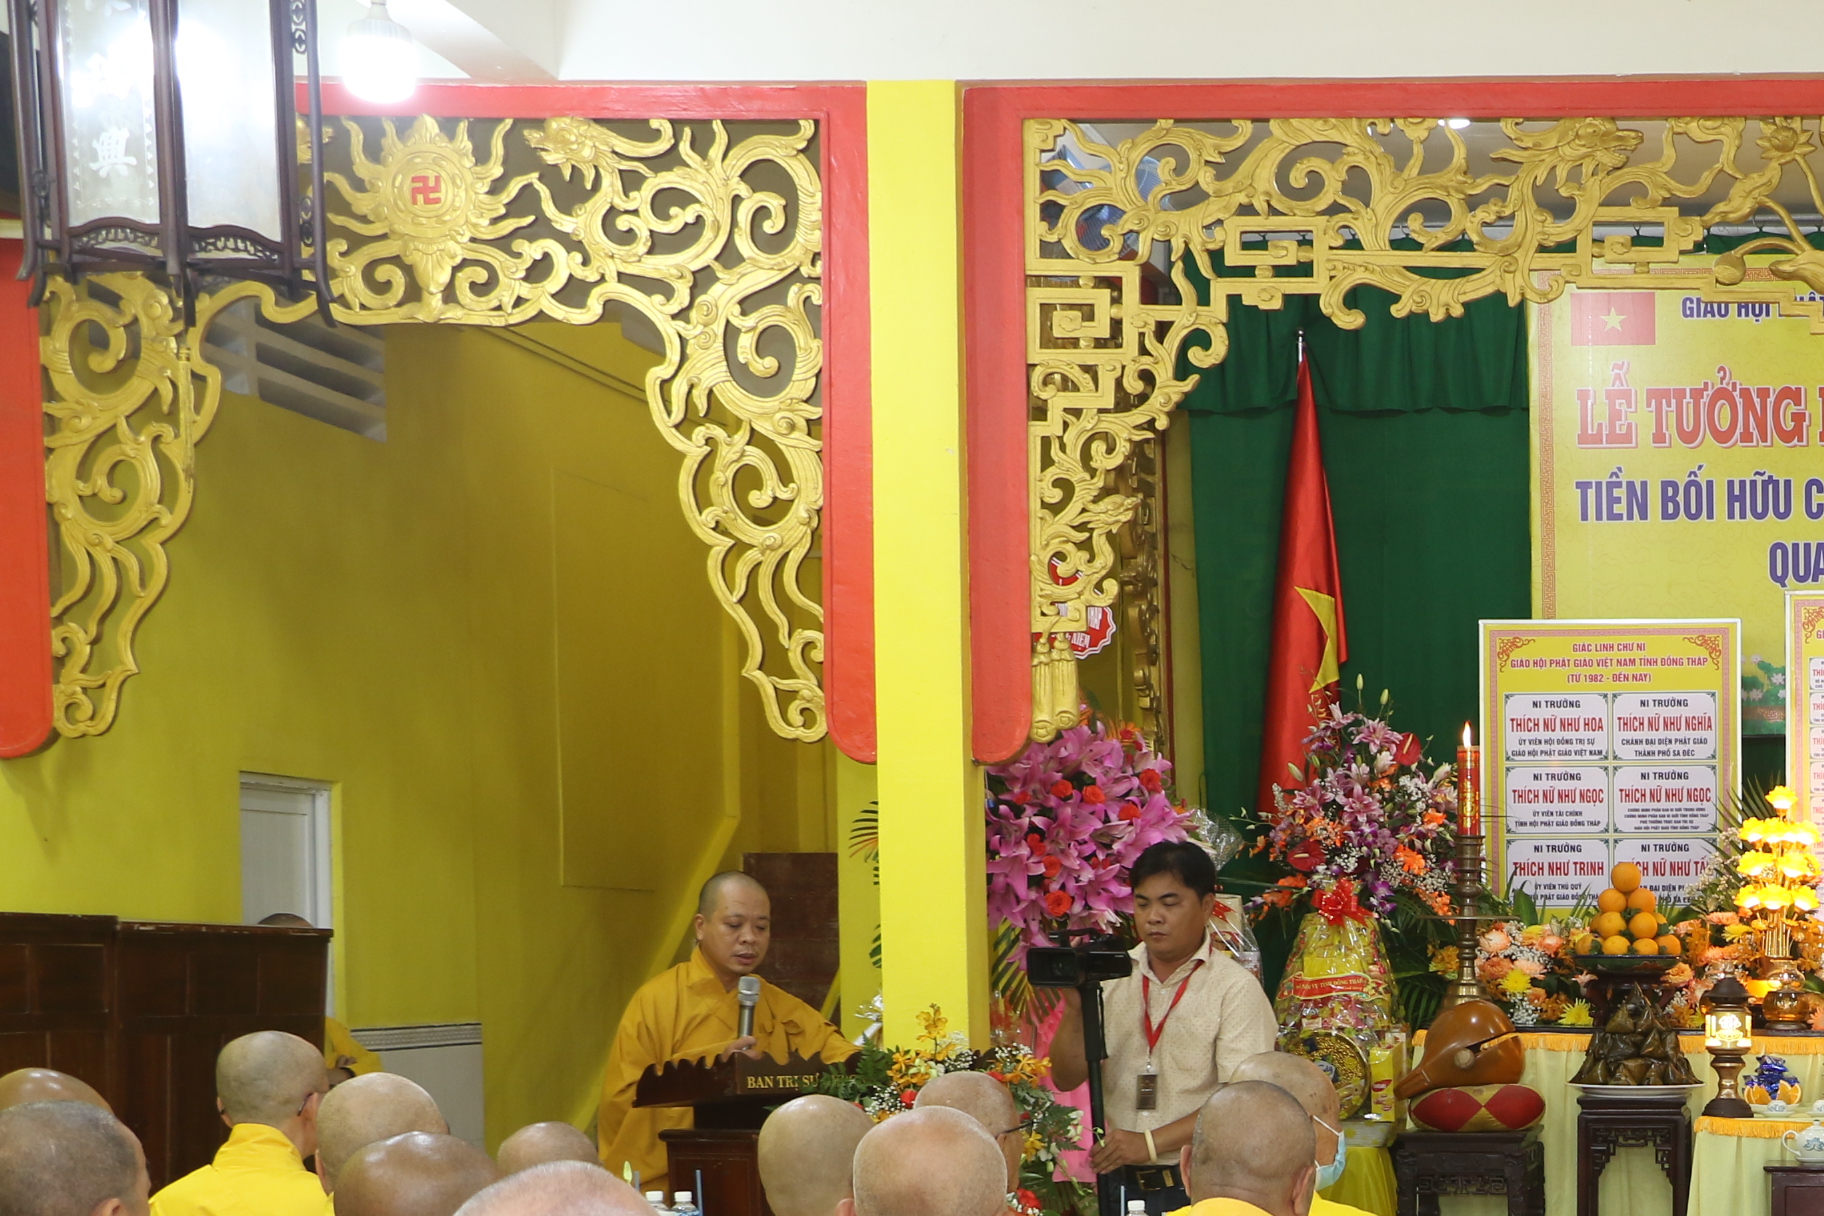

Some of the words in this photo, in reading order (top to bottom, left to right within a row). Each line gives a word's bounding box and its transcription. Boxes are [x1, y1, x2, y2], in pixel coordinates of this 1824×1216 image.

[1576, 361, 1637, 447] LỄ
[1645, 365, 1810, 448] TƯỞNG
[1575, 466, 1648, 521] TIỀN
[1660, 464, 1714, 521] BỐI
[1727, 470, 1792, 520] HỮU
[1573, 642, 1592, 653] GIÁC
[1595, 643, 1614, 653] LINH
[1617, 642, 1635, 652] CHƯ
[1637, 642, 1646, 652] NI
[1511, 658, 1530, 668] GIÁO
[1533, 658, 1547, 670] HỘI
[1550, 657, 1571, 670] PHẬT
[1574, 657, 1593, 668] GIÁO
[1596, 657, 1613, 670] VIỆT
[1616, 658, 1636, 667] NAM
[1639, 656, 1657, 667] TỈNH
[1660, 655, 1683, 667] ĐỒNG
[1686, 656, 1708, 667] THÁP
[1567, 672, 1580, 684] (TỪ
[1584, 673, 1603, 683] 1982
[1612, 672, 1629, 683] ĐẾN
[1632, 673, 1651, 684] NAY)
[1533, 700, 1541, 708] NI
[1545, 698, 1581, 708] TRƯỞNG
[1640, 699, 1649, 708] NI
[1653, 697, 1689, 708] TRƯỞNG
[1510, 715, 1539, 733] THÍCH
[1543, 714, 1557, 732] NỮ
[1560, 715, 1580, 732] NHƯ
[1584, 717, 1604, 732] HOA
[1617, 713, 1646, 732] THÍCH
[1649, 713, 1663, 732] NỮ
[1664, 714, 1682, 731] NHƯ
[1685, 712, 1712, 731] NGHĨA
[1528, 737, 1542, 745] VIÊN
[1544, 737, 1555, 747] HỘI
[1556, 736, 1573, 745] ĐỒNG
[1575, 737, 1585, 747] TRỊ
[1621, 737, 1643, 746] CHÁNH
[1645, 738, 1656, 747] ĐẠI
[1657, 737, 1672, 747] DIỆN
[1674, 736, 1691, 746] PHẬT
[1693, 736, 1707, 745] GIÁO
[1634, 748, 1655, 757] THÀNH
[1657, 747, 1670, 757] PHỐ
[1672, 749, 1680, 757] SA
[1682, 748, 1695, 757] ĐÉC
[1533, 773, 1542, 781] NI
[1546, 771, 1581, 781] TRƯỞNG
[1641, 772, 1649, 781] NI
[1653, 770, 1689, 780] TRƯỞNG
[1512, 786, 1539, 803] THÍCH
[1542, 785, 1555, 803] NỮ
[1557, 786, 1576, 803] NHƯ
[1579, 788, 1604, 806] NGỌC
[1619, 785, 1646, 803] THÍCH
[1649, 785, 1662, 803] NỮ
[1665, 786, 1684, 803] NHƯ
[1687, 788, 1711, 806] NGỌC
[1534, 845, 1543, 853] NI
[1546, 843, 1582, 853] TRƯỞNG
[1653, 842, 1690, 852] TRƯỞNG
[1513, 859, 1544, 876] THÍCH
[1548, 859, 1570, 876] NHƯ
[1574, 861, 1604, 876] TRINH
[1653, 857, 1667, 876] NỮ
[1670, 858, 1690, 876] NHƯ
[746, 1076, 773, 1089] BAN
